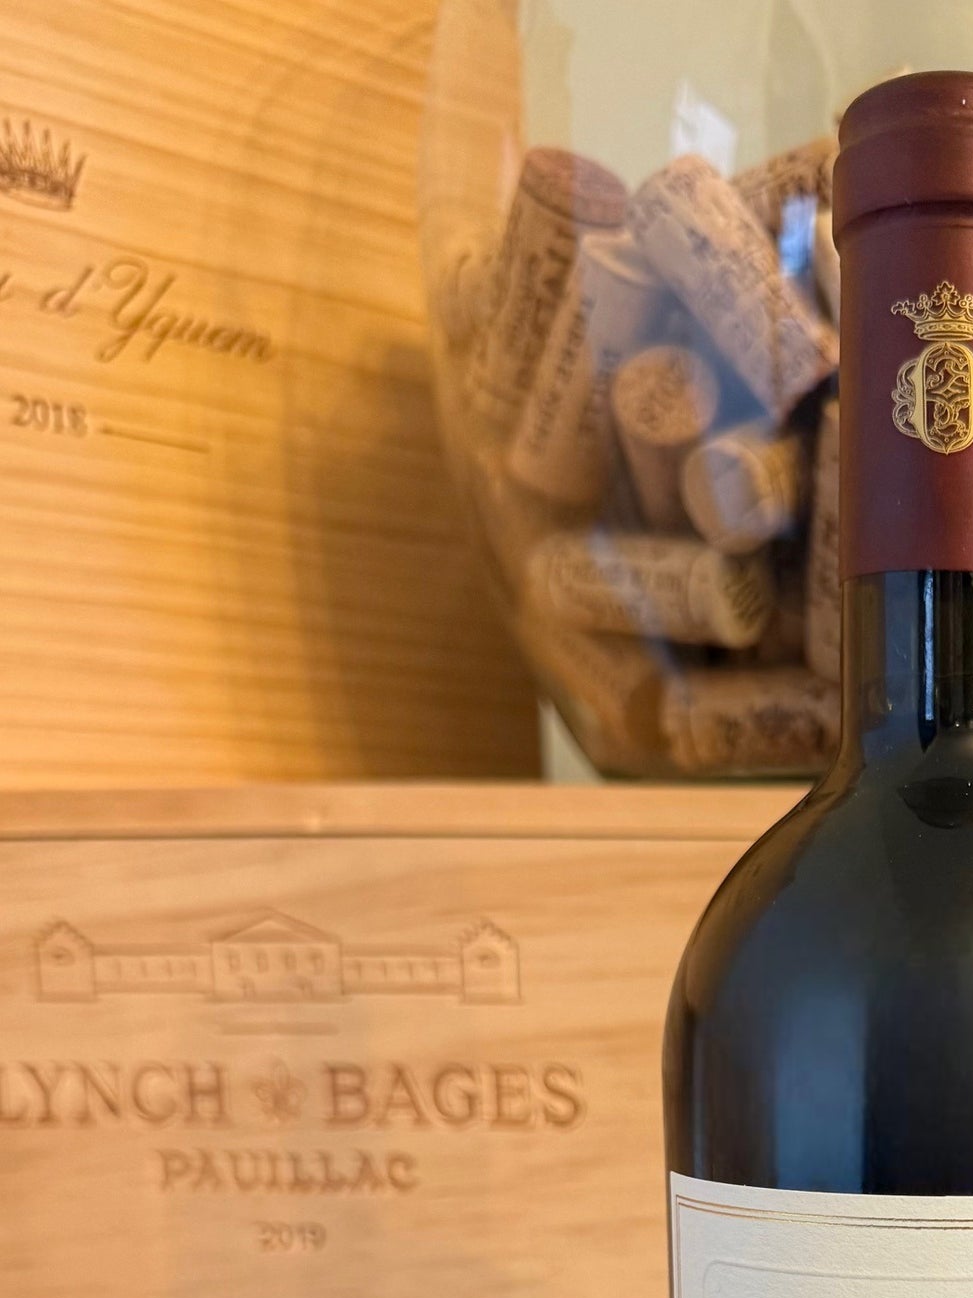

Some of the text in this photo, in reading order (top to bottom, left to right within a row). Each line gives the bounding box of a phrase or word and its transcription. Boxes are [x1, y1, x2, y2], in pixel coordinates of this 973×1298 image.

[10, 394, 88, 437] 2018
[0, 1059, 587, 1130] LYNCH BAGES
[158, 1148, 420, 1193] PAUILLAC
